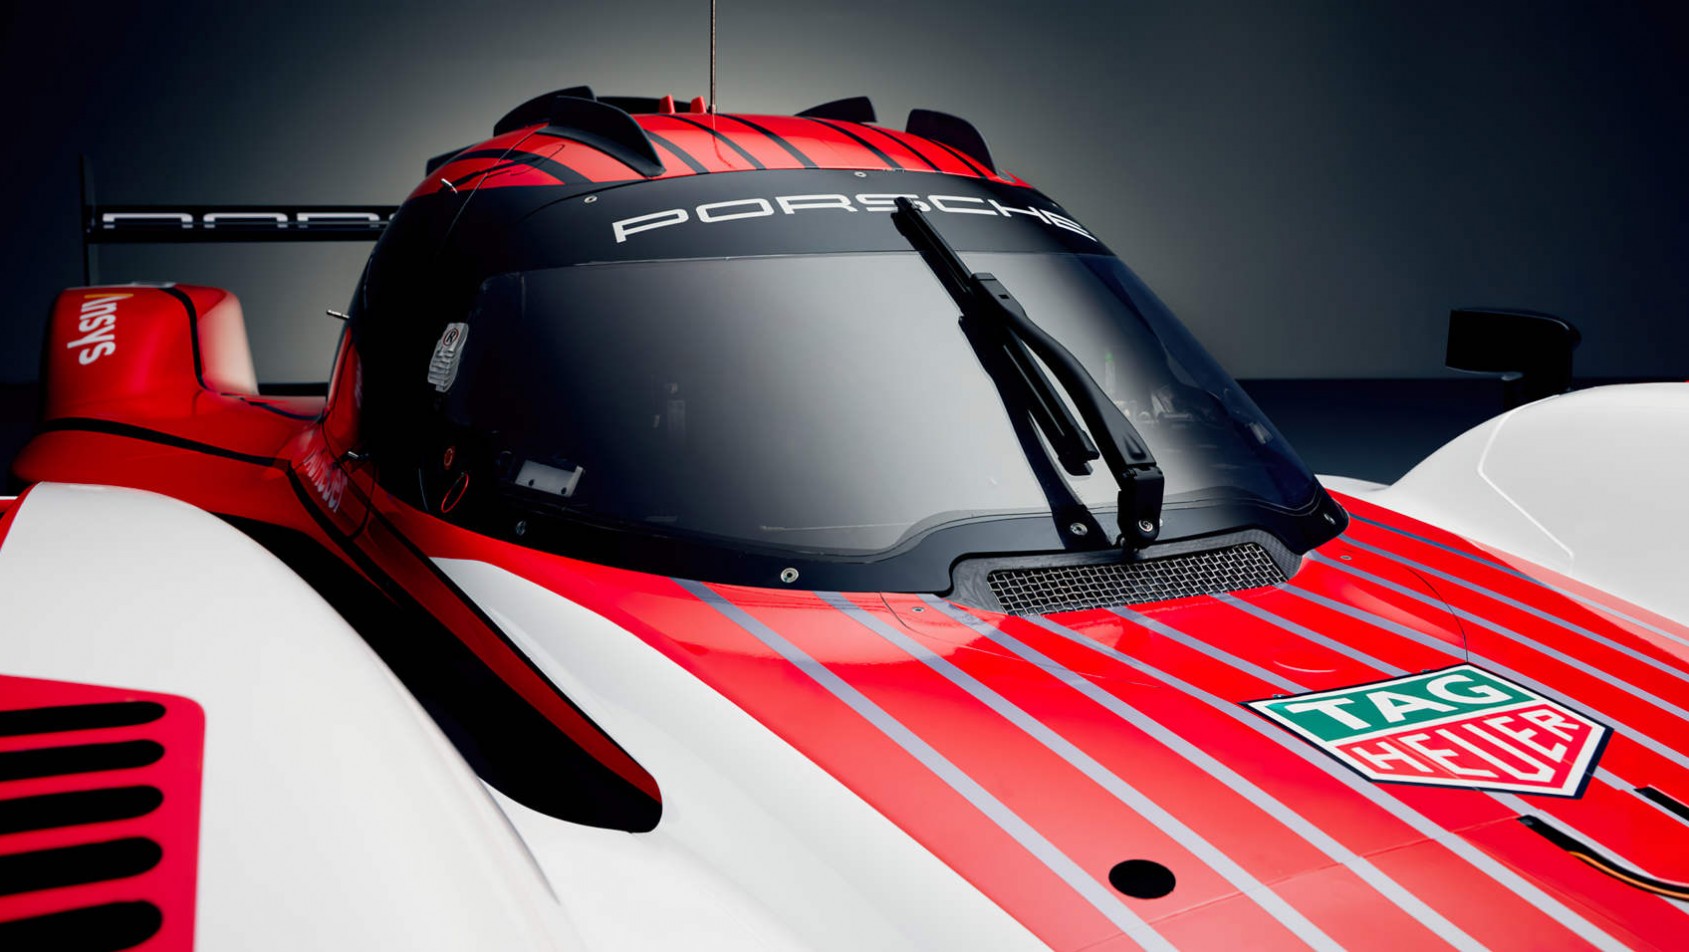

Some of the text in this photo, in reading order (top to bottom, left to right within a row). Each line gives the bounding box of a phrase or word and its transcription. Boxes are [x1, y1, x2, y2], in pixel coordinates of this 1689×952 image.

[611, 192, 1098, 243] PORSCHE
[67, 293, 134, 366] Ansys
[1285, 674, 1513, 731] TAG
[1350, 708, 1580, 784] HEUER
